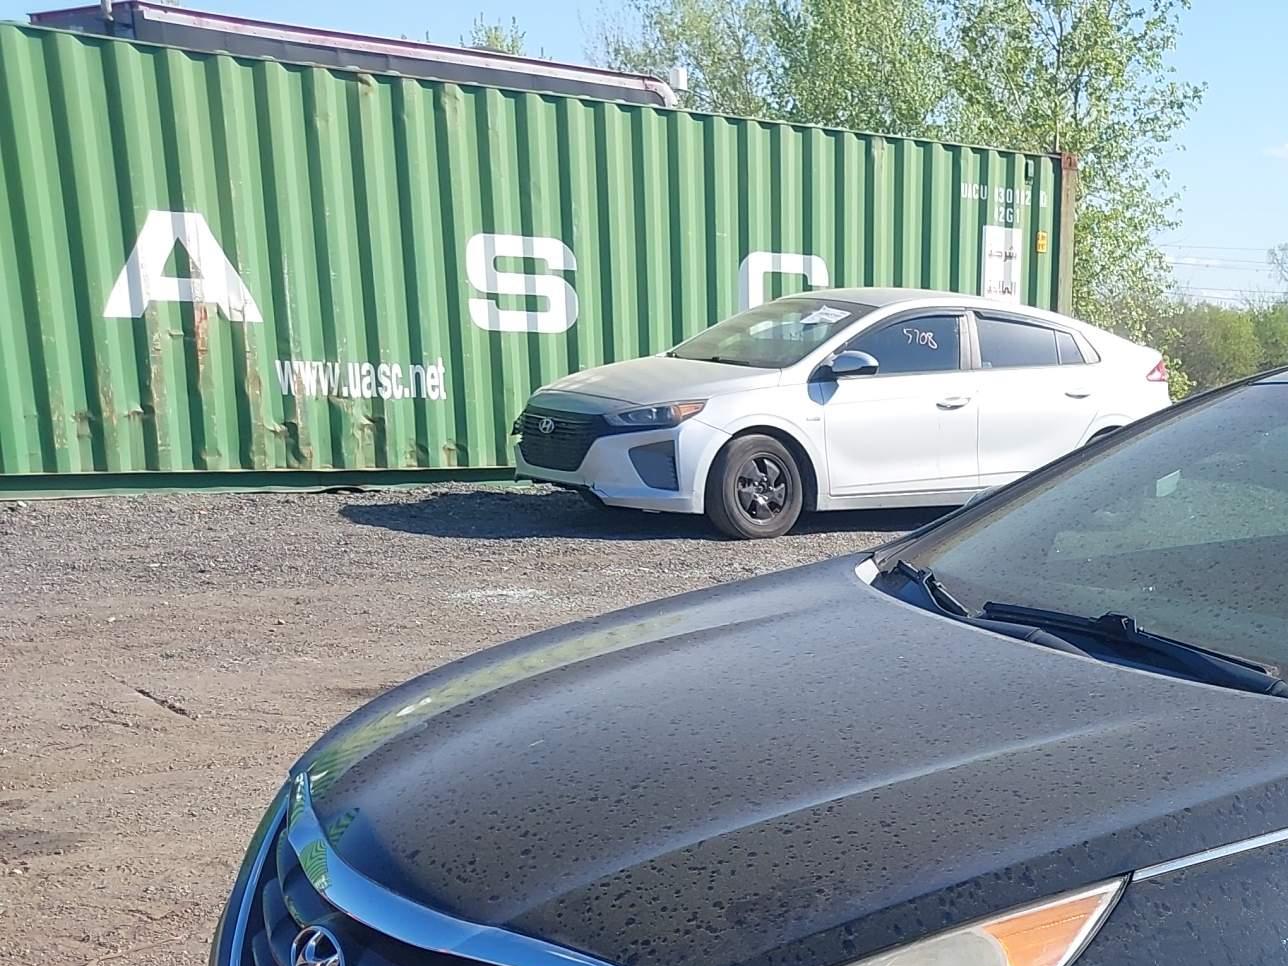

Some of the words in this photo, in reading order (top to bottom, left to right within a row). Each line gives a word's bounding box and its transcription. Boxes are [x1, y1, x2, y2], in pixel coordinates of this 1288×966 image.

[103, 210, 263, 322] A
[466, 233, 579, 333] S
[903, 328, 938, 349] 5708
[275, 357, 447, 400] www.uasc.net
